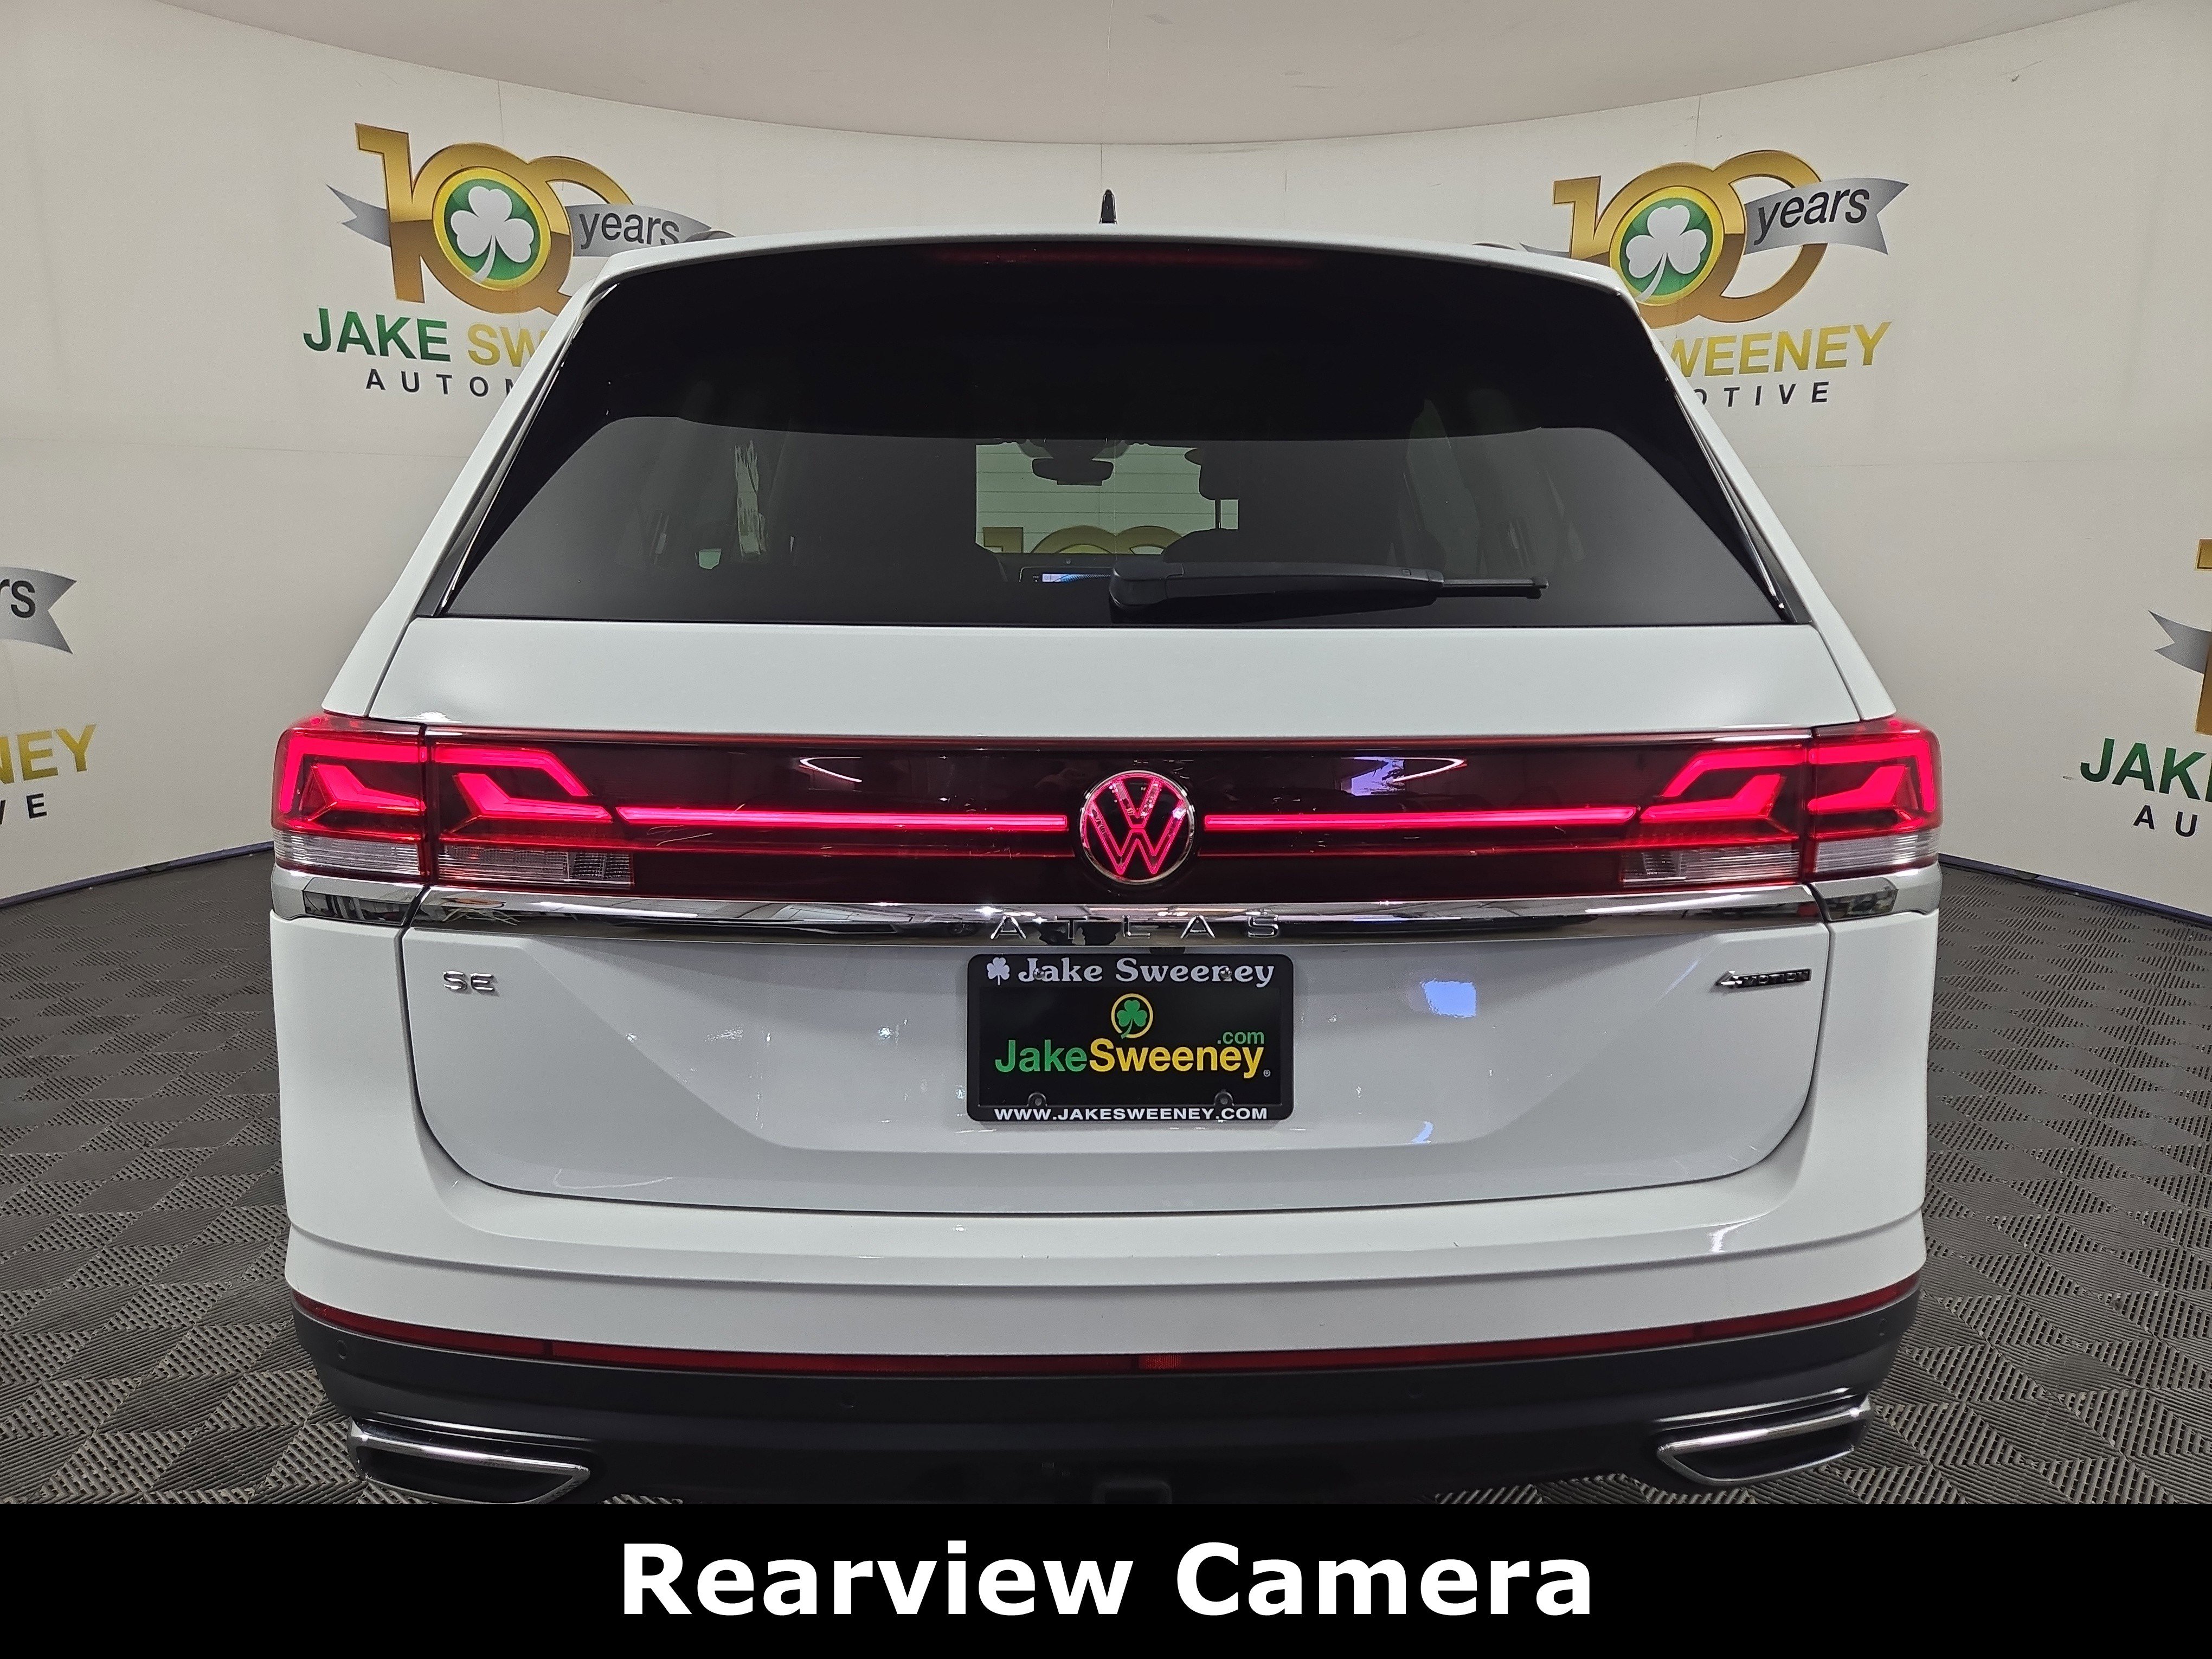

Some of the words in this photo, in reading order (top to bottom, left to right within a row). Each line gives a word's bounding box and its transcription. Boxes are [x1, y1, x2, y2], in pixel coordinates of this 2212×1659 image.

[578, 212, 681, 249] years
[1753, 186, 1869, 246] years
[303, 307, 451, 362] JAKE
[1660, 321, 1893, 378] WEENEY
[2080, 737, 2212, 802] JAK
[991, 914, 1279, 940] ATLAS
[442, 970, 496, 992] SE
[1019, 957, 1103, 982] Jake
[1116, 957, 1275, 988] Sweeney
[1217, 1031, 1265, 1045] .com
[994, 1108, 1268, 1121] WWW.JAKESWEENEY.COM
